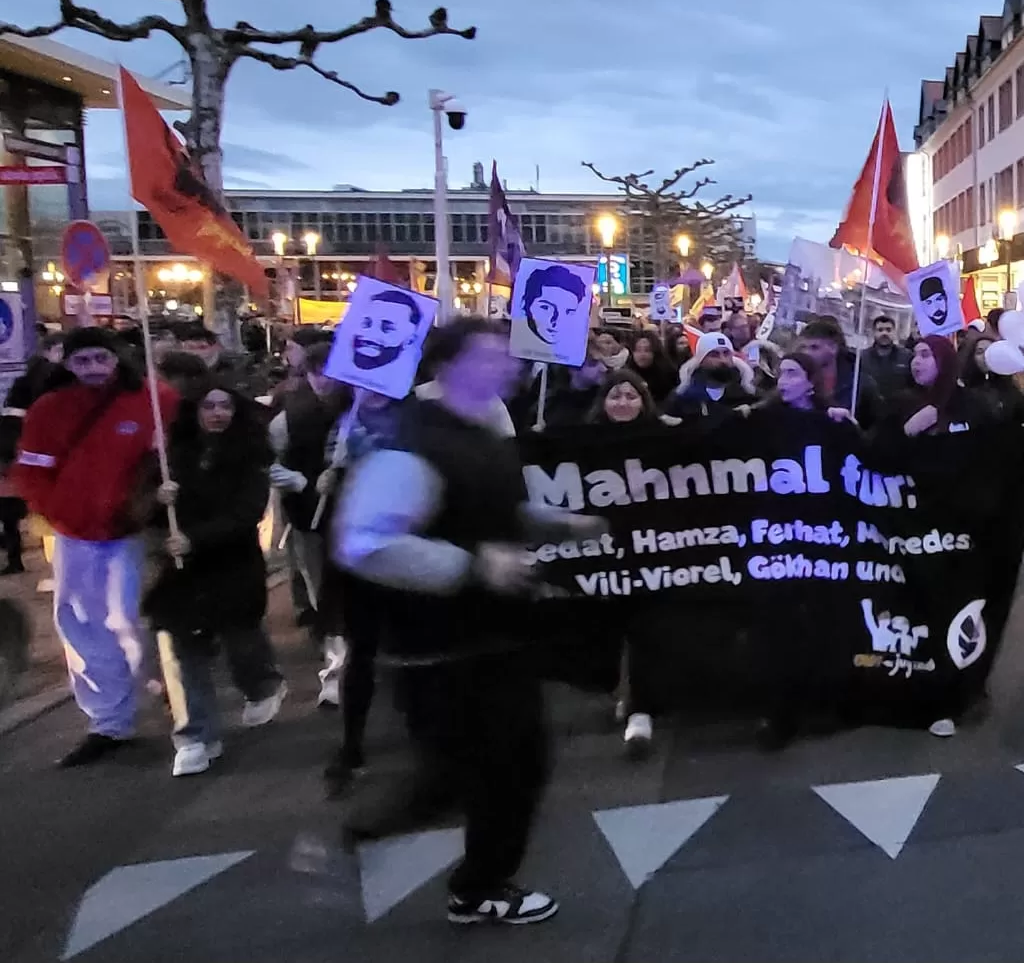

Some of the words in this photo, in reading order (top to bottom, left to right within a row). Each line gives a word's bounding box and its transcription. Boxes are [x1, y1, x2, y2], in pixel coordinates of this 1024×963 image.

[522, 445, 830, 510] Mahnmal
[632, 525, 747, 554] Hamza,
[751, 519, 850, 548] Ferhat,
[575, 556, 742, 596] Vili-Viorel,
[747, 554, 850, 581] Gökhan
